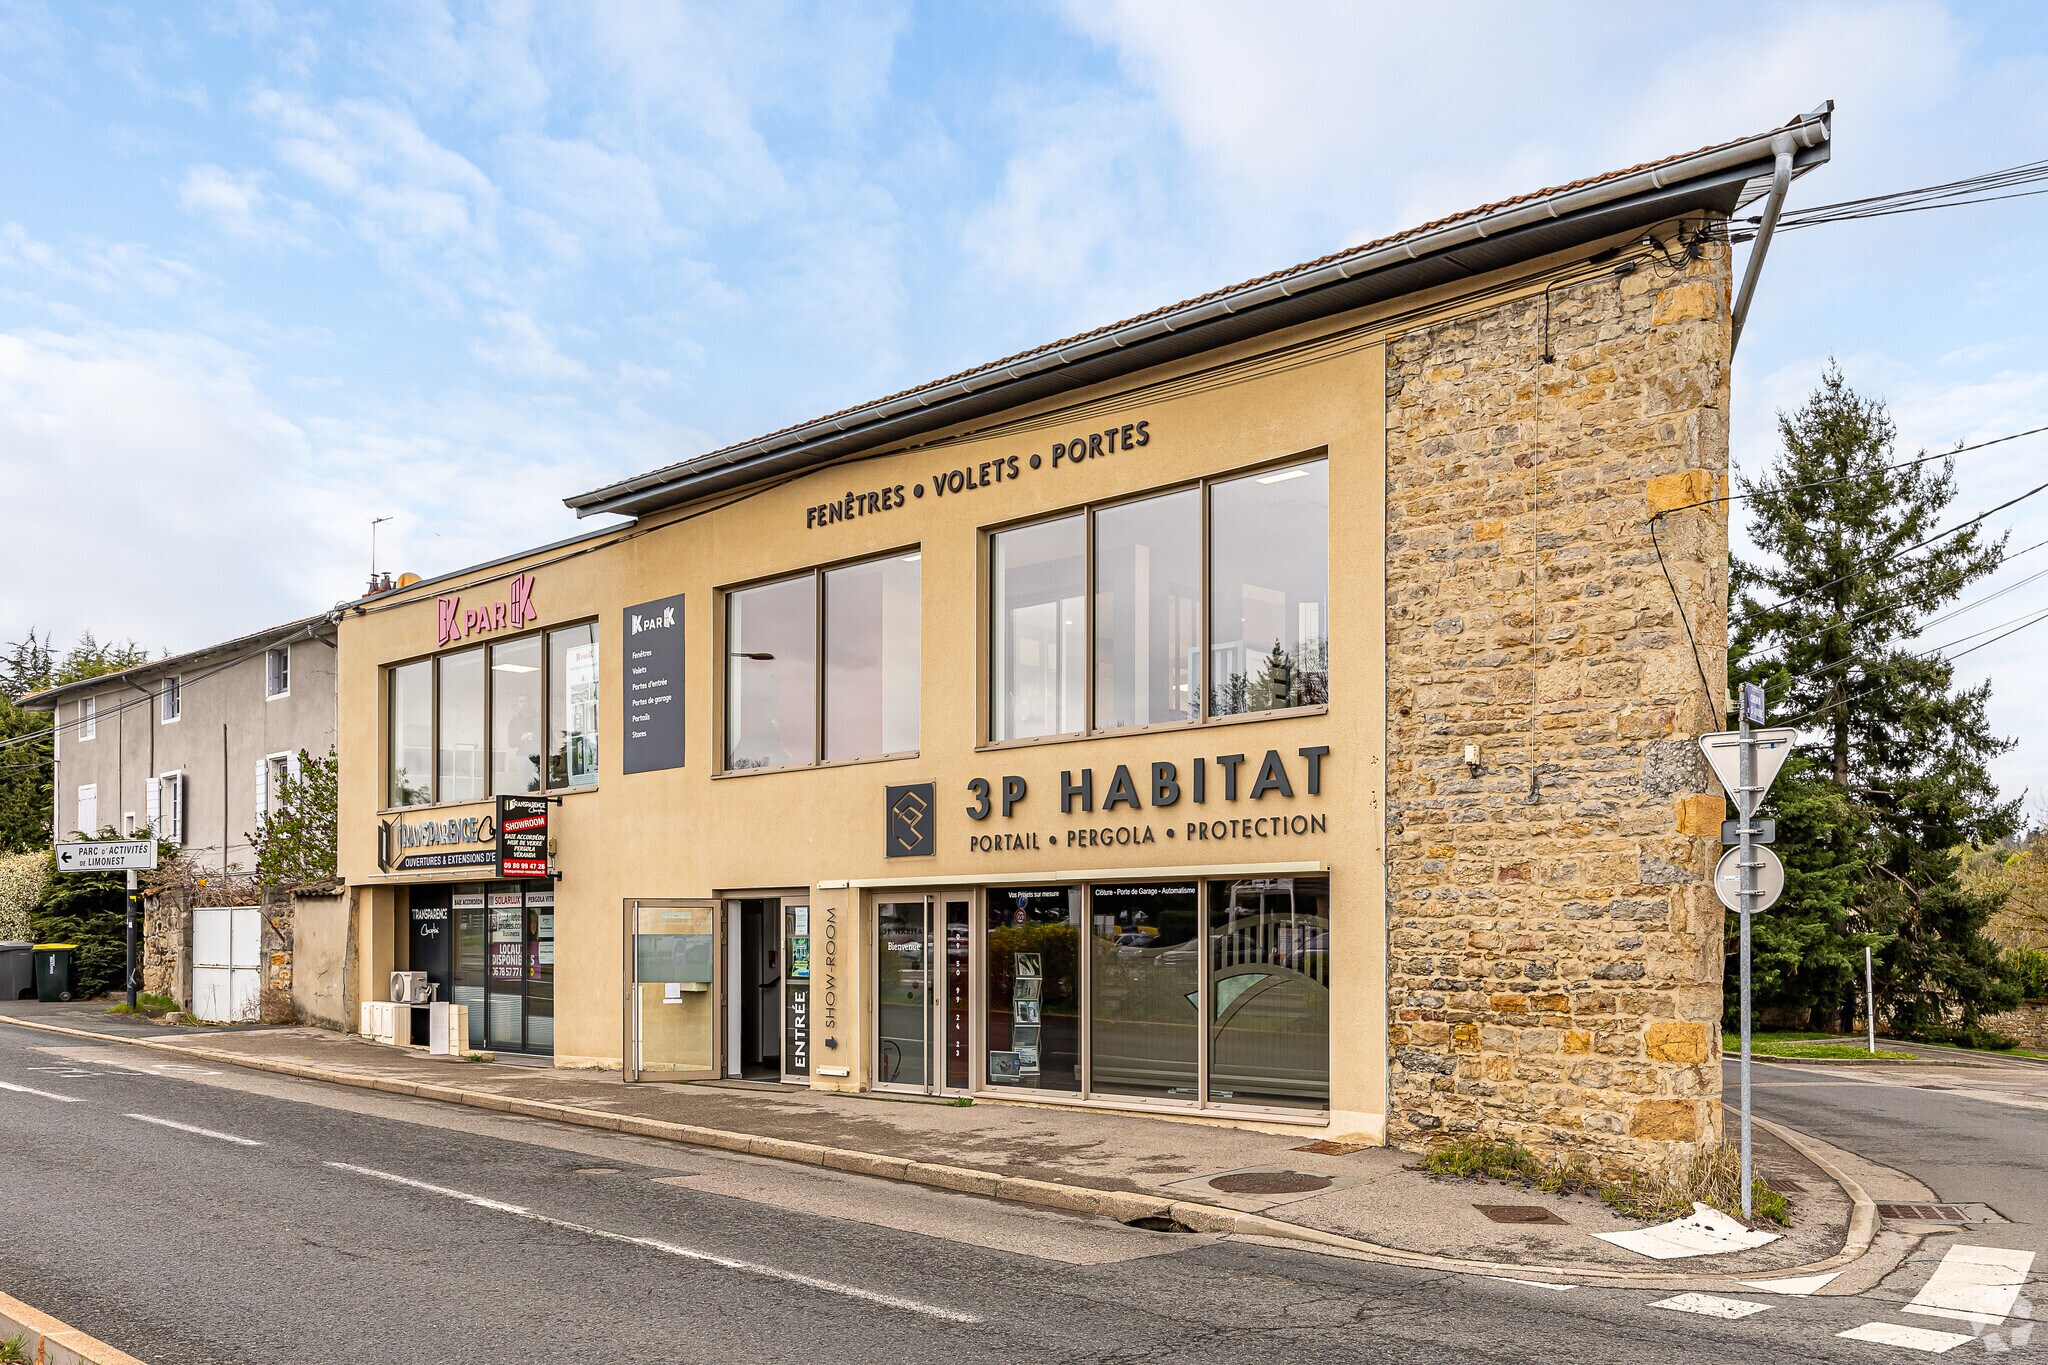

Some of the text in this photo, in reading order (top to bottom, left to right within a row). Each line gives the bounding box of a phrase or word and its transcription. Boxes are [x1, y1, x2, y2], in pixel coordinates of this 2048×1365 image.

[806, 420, 1149, 529] FENÊTRES VOLETS PORTES
[632, 650, 652, 659] Fenêtres
[632, 667, 647, 675] Volets
[632, 678, 668, 691] Portes d'entrée
[632, 699, 647, 707] Portes
[654, 694, 672, 705] garage
[632, 713, 651, 722] Portails
[632, 730, 647, 738] Stores
[966, 745, 1330, 821] 3P HABITAT
[505, 817, 545, 831] SHOWROOM
[397, 817, 478, 848] TRANSPARENCE
[970, 813, 1327, 852] PORTAIL PERGOLA PROTECTION
[78, 847, 99, 856] PARC
[88, 856, 126, 866] LIMONEST
[405, 856, 441, 867] OUVERTURES
[442, 855, 447, 865] &
[447, 853, 485, 865] EXTENSIONS
[1017, 891, 1033, 899] Projets
[1138, 887, 1158, 896] Garage
[887, 942, 922, 951] Bienvenue
[825, 907, 836, 1029] SHOW-ROOM
[792, 991, 806, 1068] ENTRÉE
